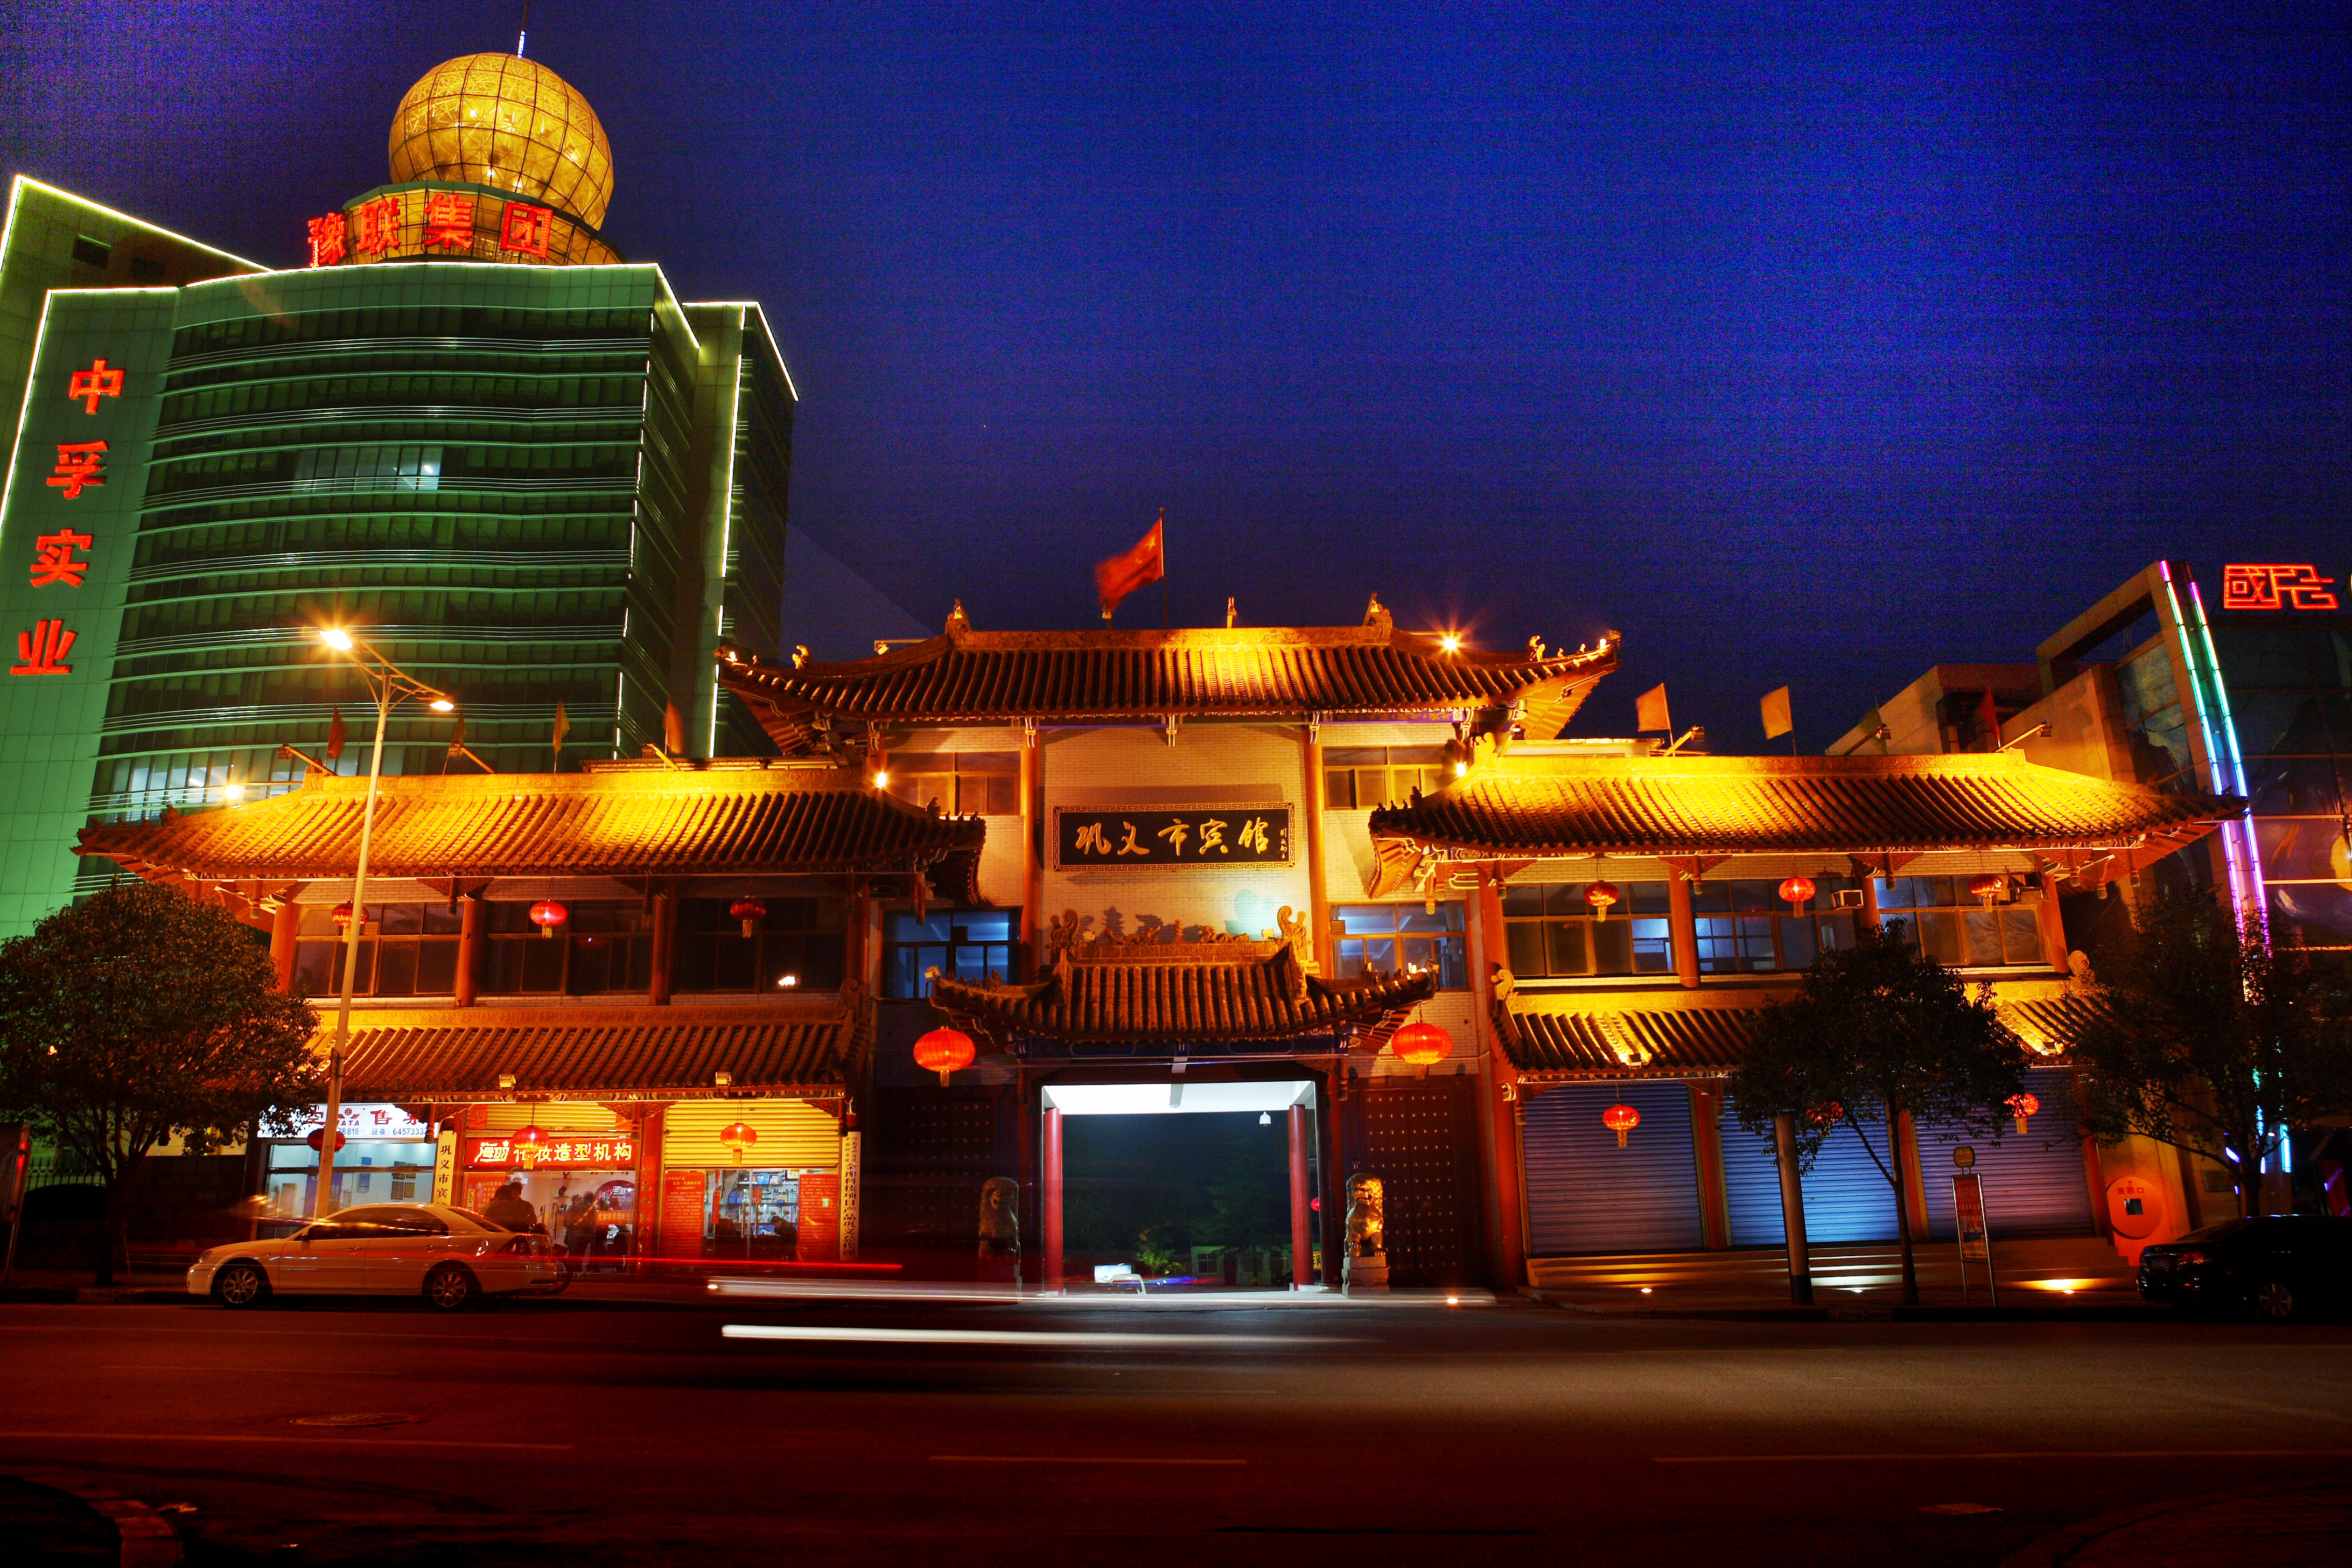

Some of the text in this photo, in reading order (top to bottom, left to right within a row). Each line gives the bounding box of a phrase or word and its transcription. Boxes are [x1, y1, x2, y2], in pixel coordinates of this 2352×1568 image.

[307, 193, 554, 268] 豫联集团
[10, 359, 124, 675] 中孚实业
[1075, 817, 1269, 856] 巩义市宾馆
[436, 1145, 451, 1206] 巩义市宾
[2117, 1186, 2144, 1195] 售票口
